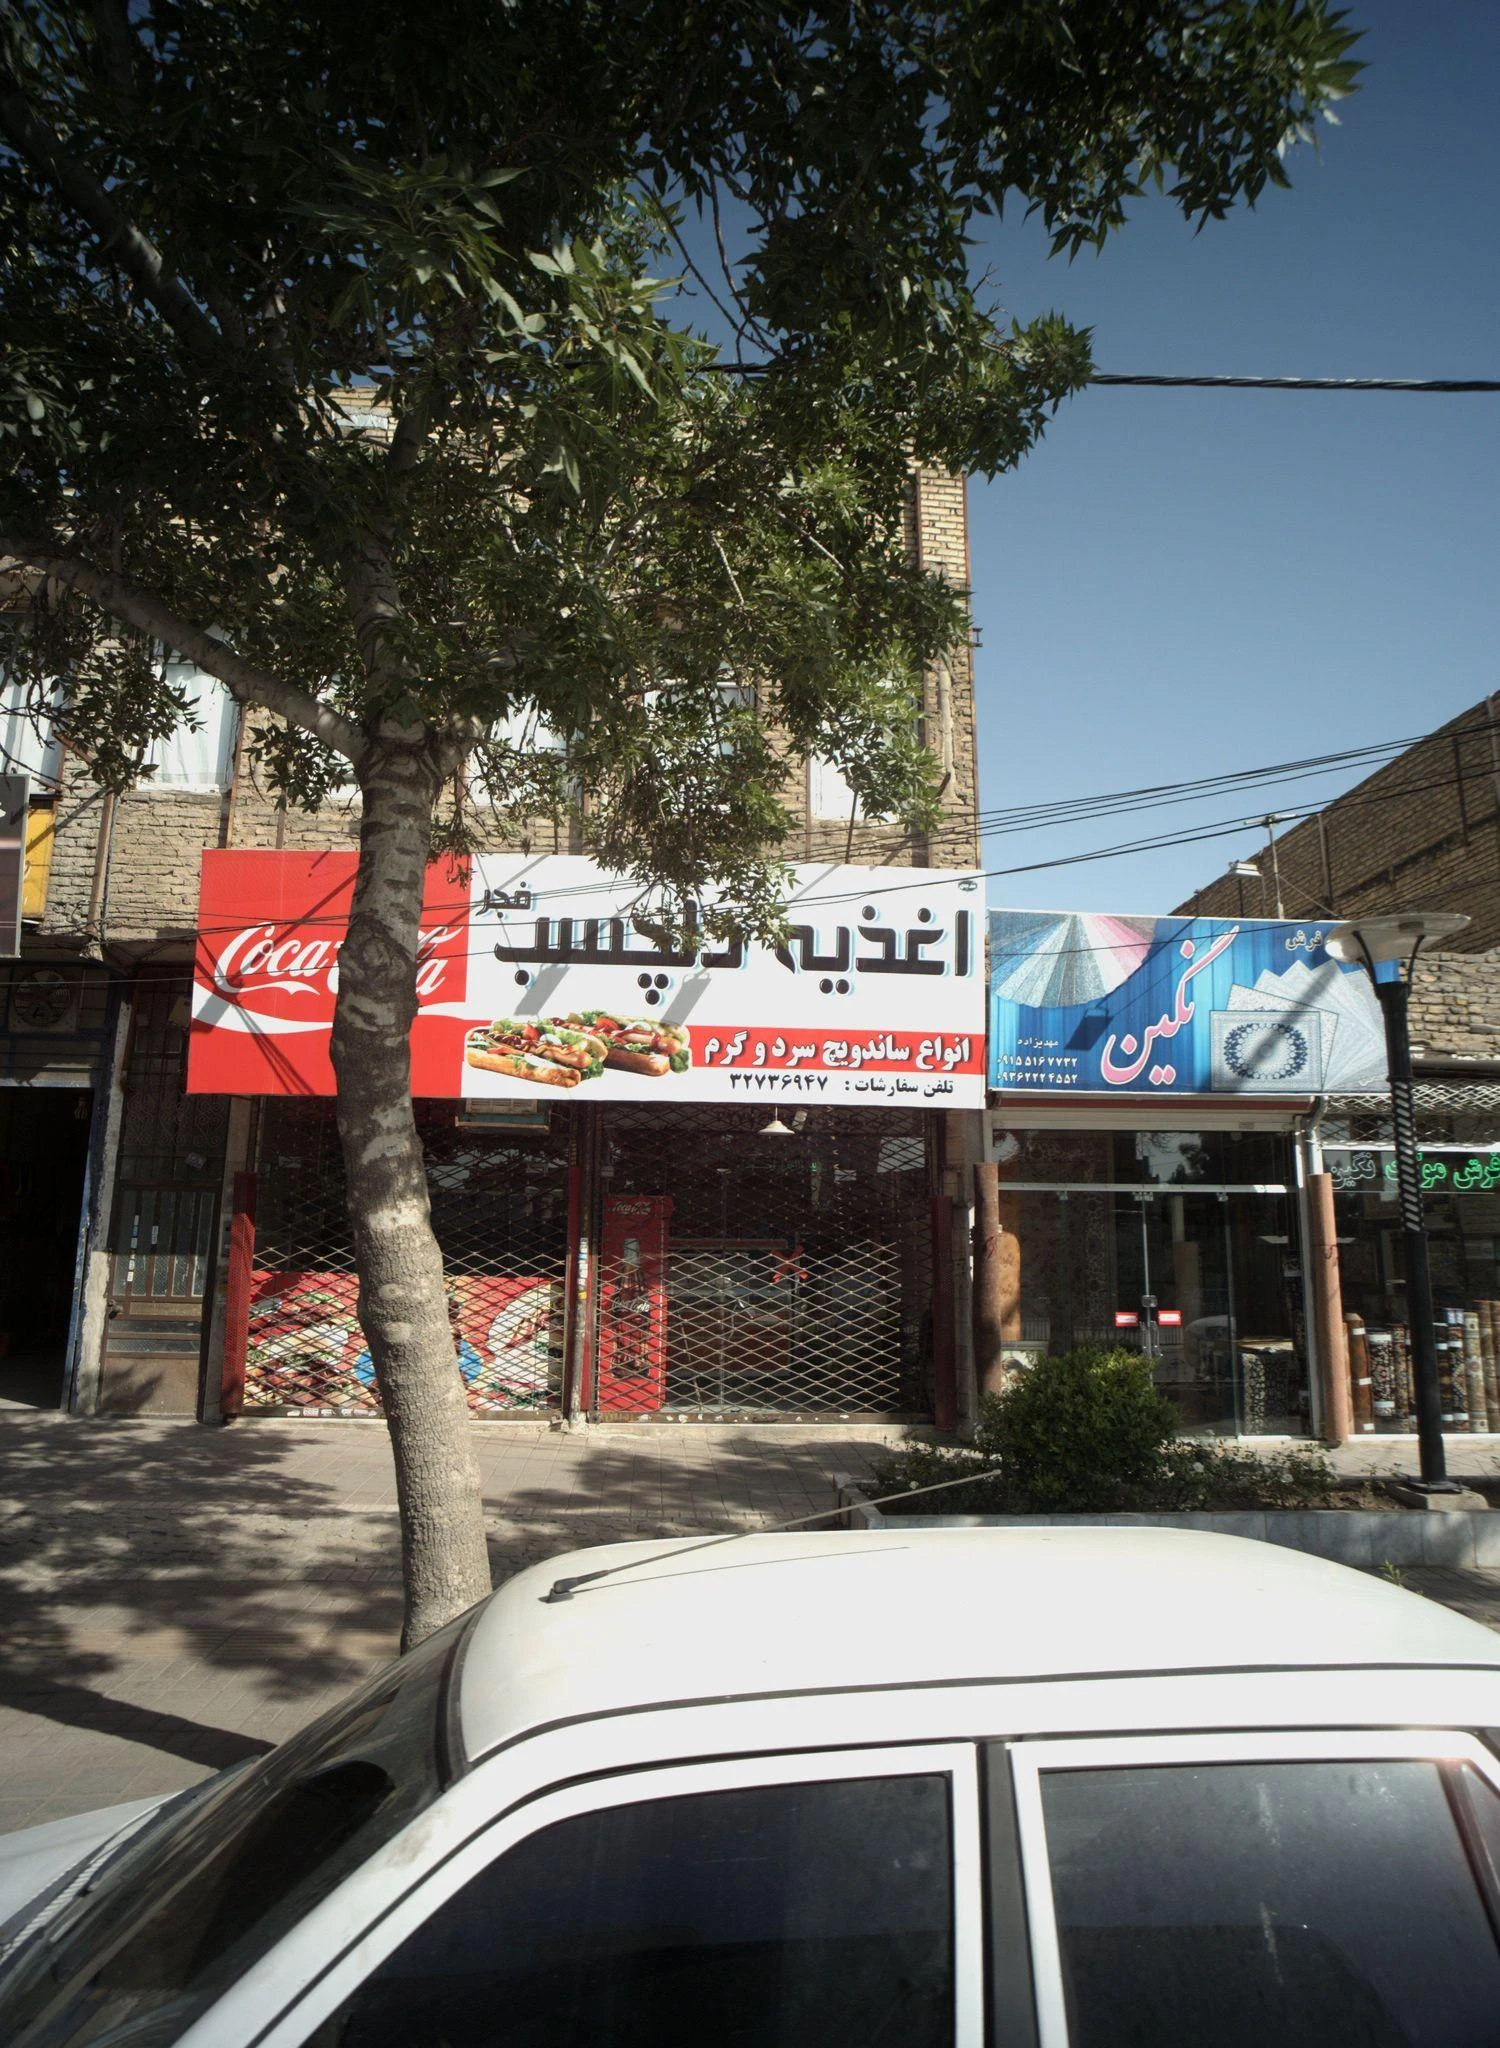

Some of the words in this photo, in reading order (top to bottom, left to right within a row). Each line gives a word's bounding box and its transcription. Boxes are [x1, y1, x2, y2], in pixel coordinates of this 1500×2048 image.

[475, 881, 532, 919] فجر
[1285, 929, 1323, 952] فرش
[1100, 924, 1240, 1086] نگین
[704, 1030, 748, 1065] گرم
[752, 1041, 766, 1066] و
[772, 1036, 816, 1067] سرد
[822, 1034, 910, 1068] ساندویچ
[916, 1034, 971, 1071] انواع
[729, 1073, 828, 1092] ۳۲۷۳۶۹۴۷
[924, 1077, 954, 1097] تلفن
